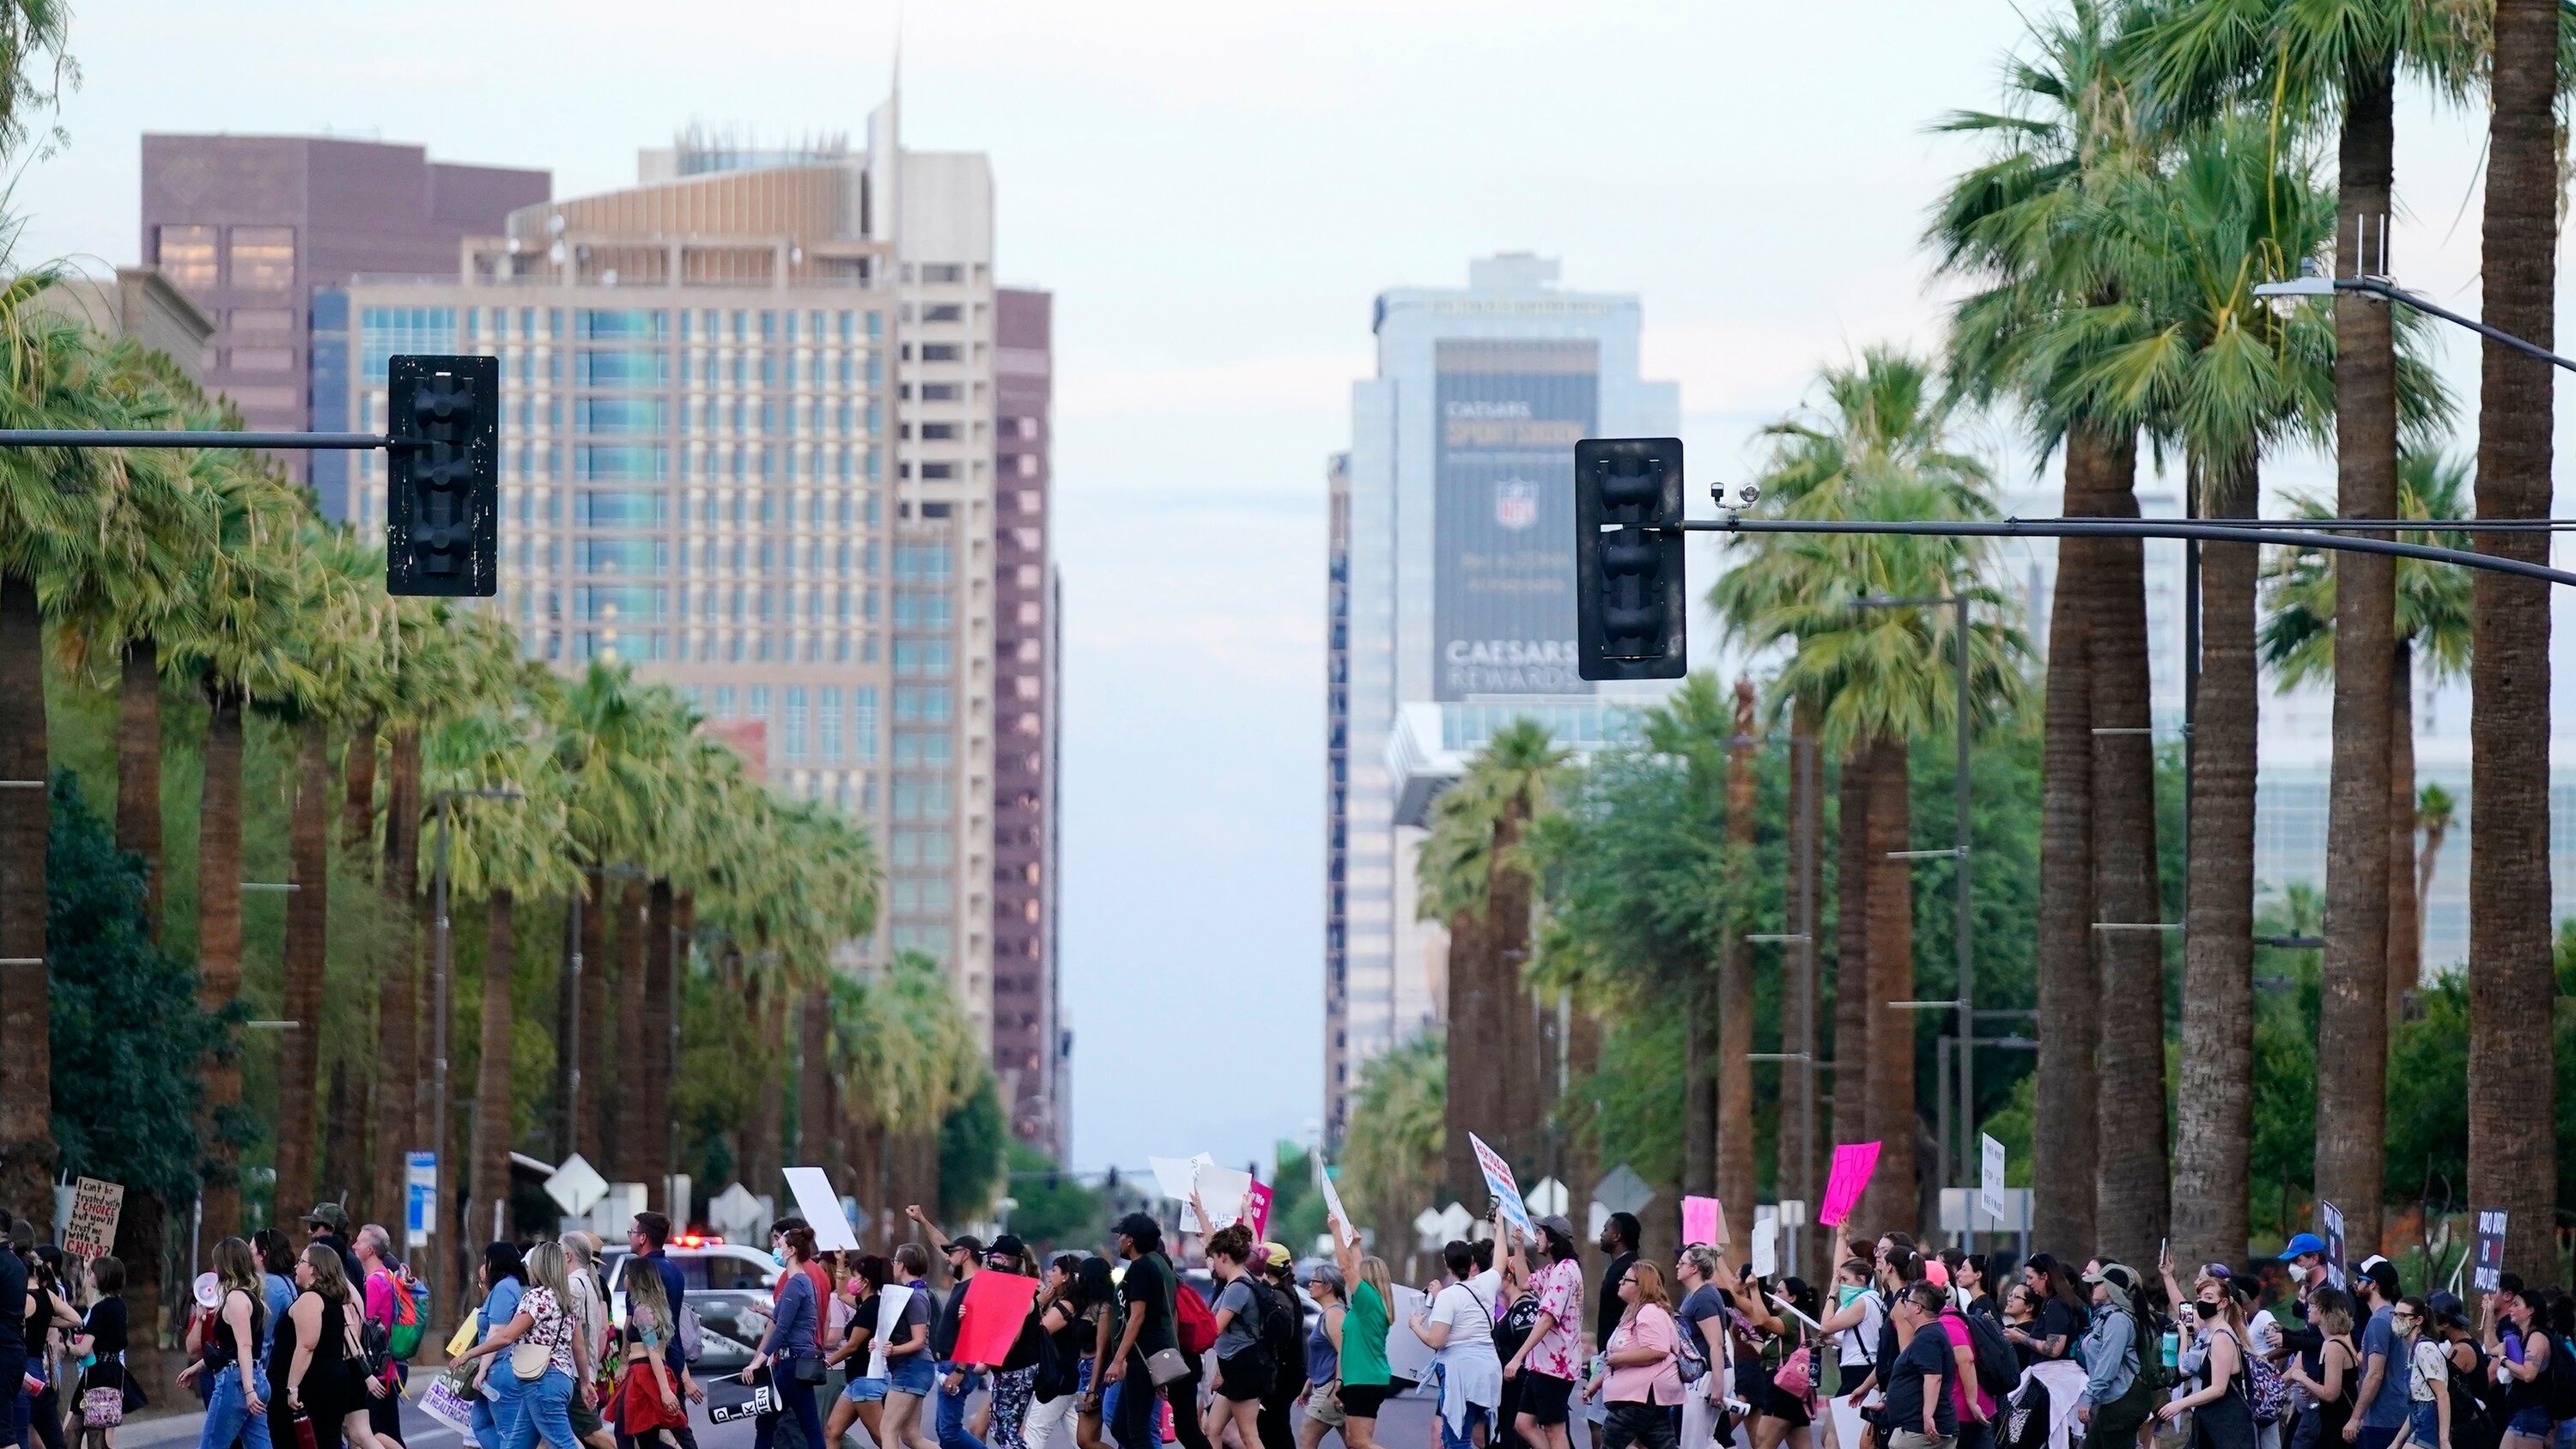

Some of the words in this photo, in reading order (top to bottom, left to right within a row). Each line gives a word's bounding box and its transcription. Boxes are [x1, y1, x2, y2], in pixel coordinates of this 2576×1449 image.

[1447, 639, 1578, 667] CAESARS
[1447, 667, 1580, 690] REWARDS
[78, 1178, 82, 1190] I
[104, 1184, 113, 1195] be
[76, 1190, 105, 1205] trusted
[105, 1197, 120, 1209] with
[82, 1202, 117, 1217] CHOICE
[72, 1209, 89, 1221] but
[2324, 1203, 2335, 1231] PRO
[2478, 1210, 2494, 1234] PRO
[68, 1231, 90, 1243] with
[94, 1236, 100, 1245] a
[70, 1220, 92, 1233] trust
[91, 1227, 103, 1236] me
[2329, 1234, 2336, 1259] IS
[2482, 1239, 2491, 1263] IS
[2327, 1261, 2337, 1289] PRO
[2475, 1266, 2488, 1290] PRO
[2487, 1267, 2499, 1292] LIFE
